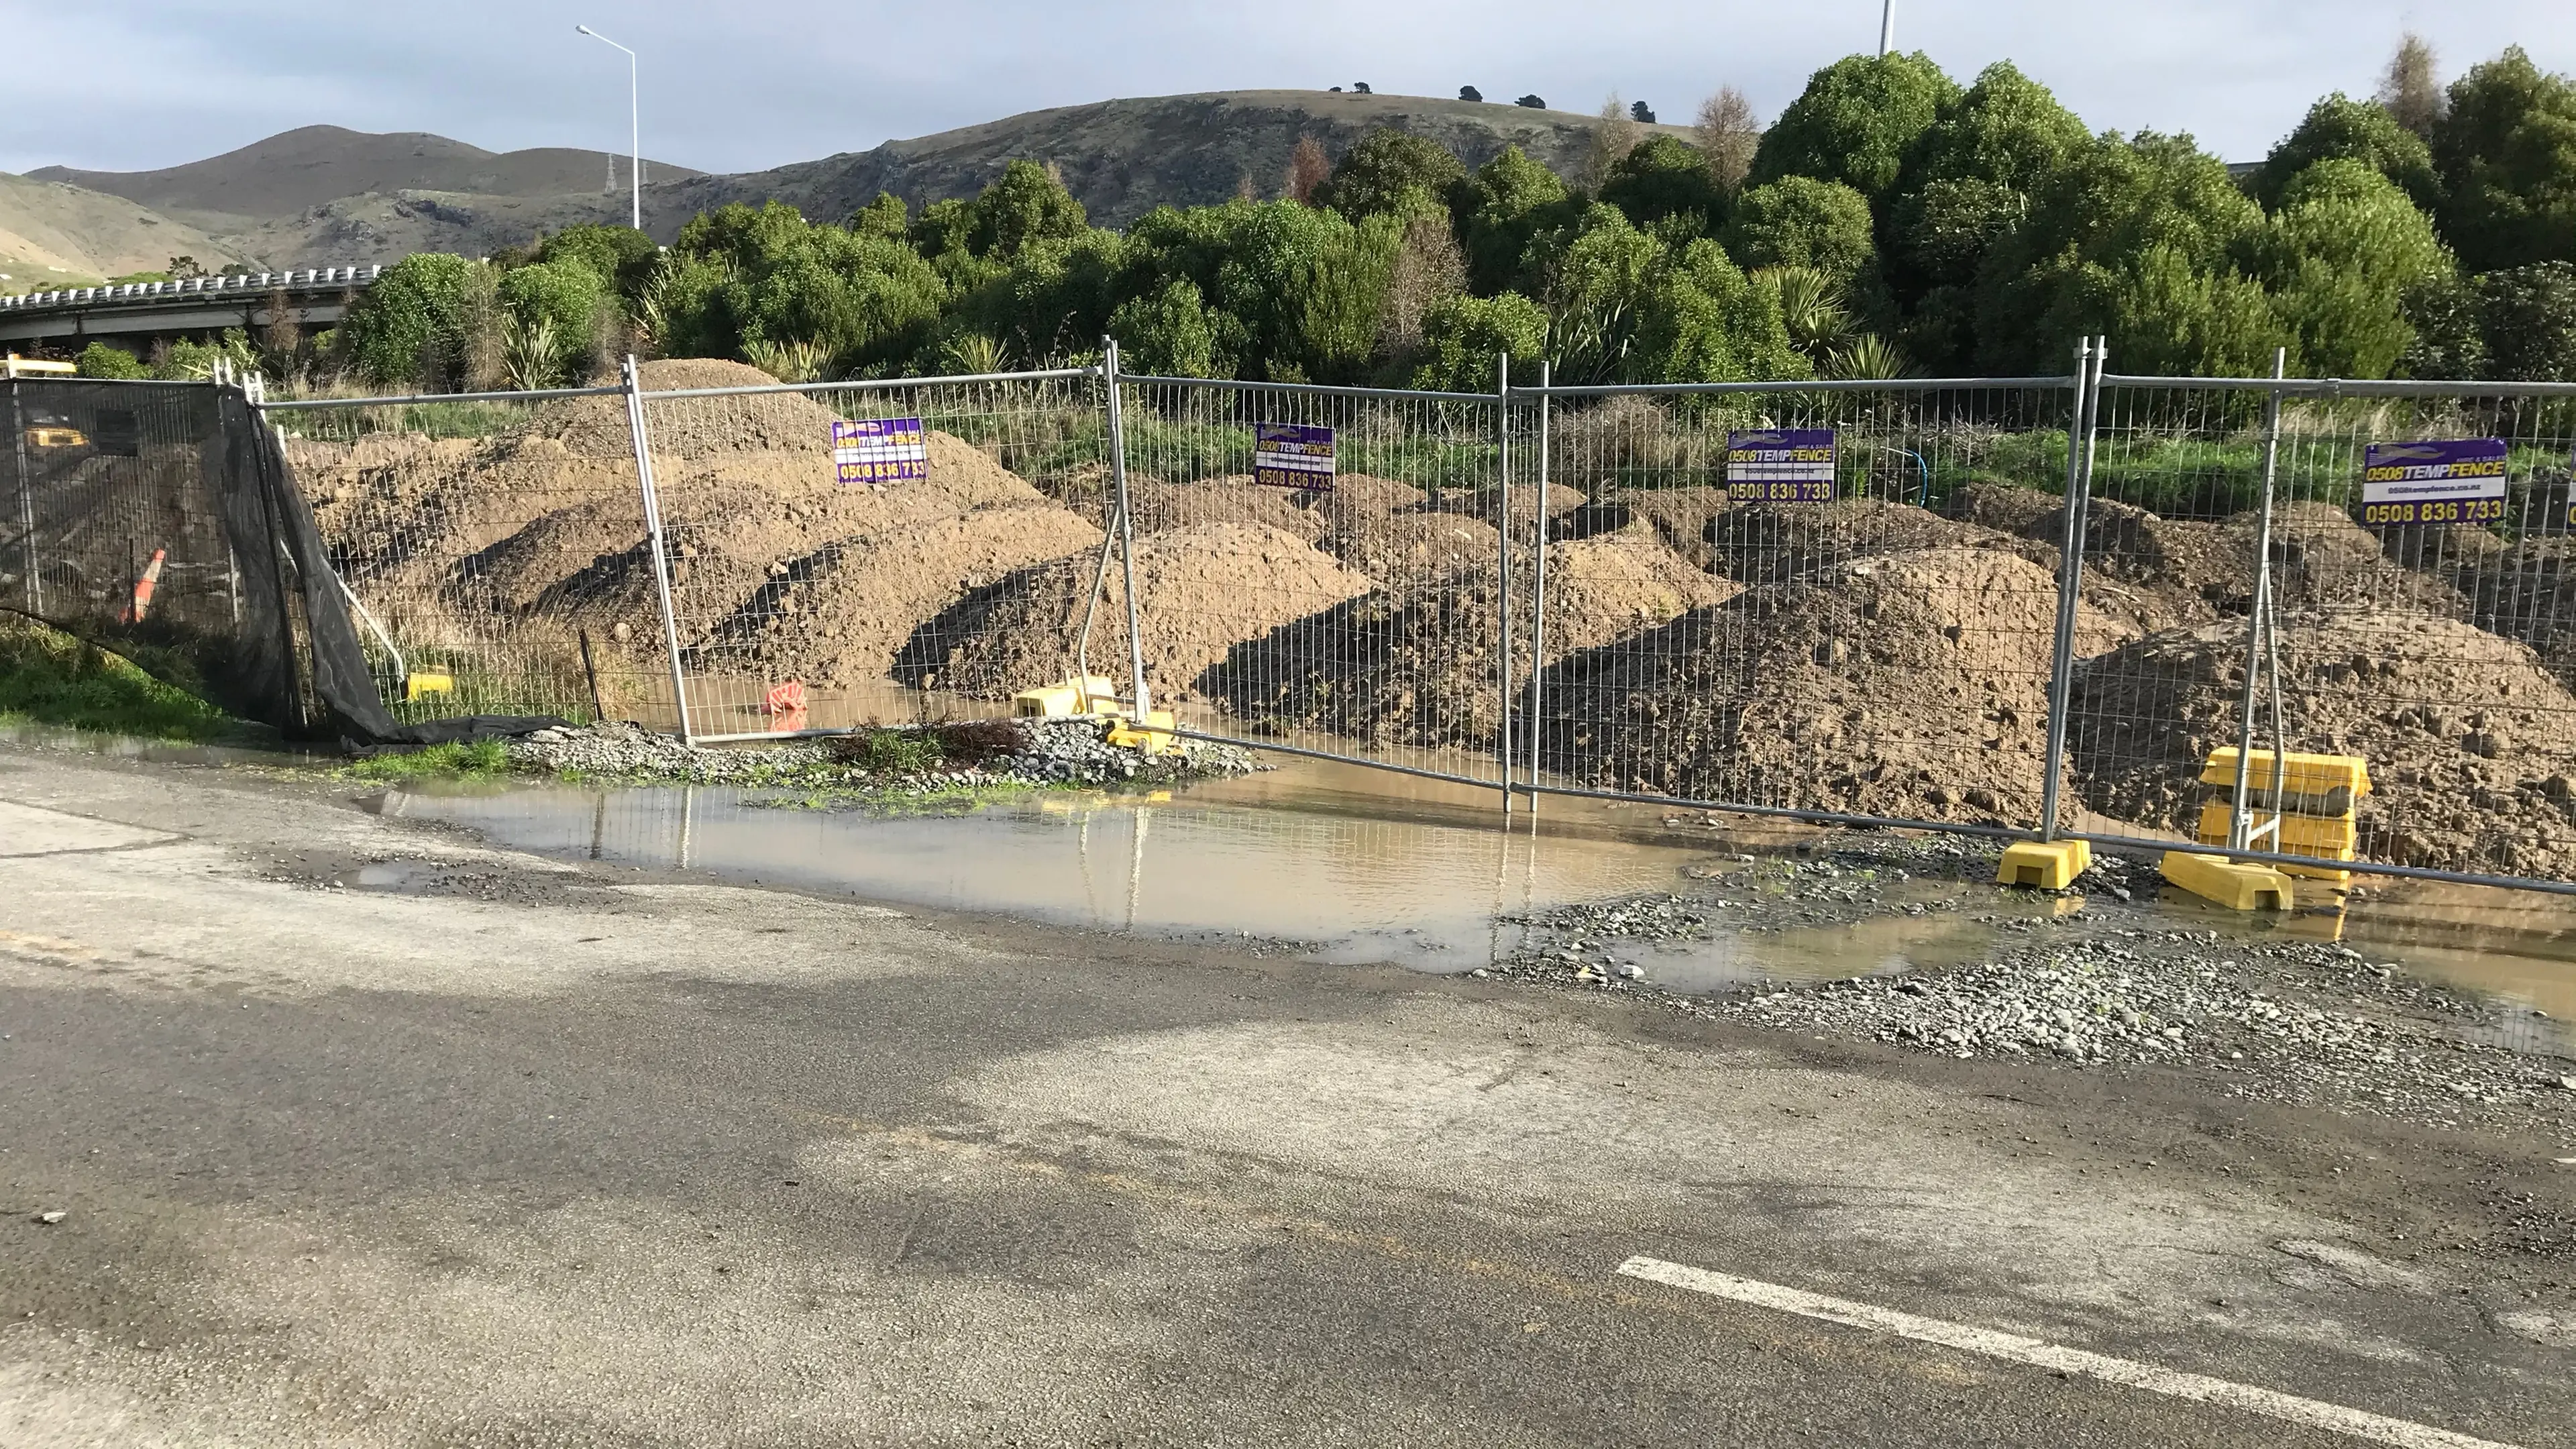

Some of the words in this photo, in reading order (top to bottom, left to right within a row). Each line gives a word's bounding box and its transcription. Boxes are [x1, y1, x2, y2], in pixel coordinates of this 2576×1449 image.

[1259, 440, 1332, 455] 0508TEMPFENCE
[1729, 449, 1832, 462] 0508TEMPFENCE
[841, 464, 872, 479] 0508
[875, 463, 899, 477] 836
[902, 461, 924, 476] 733
[1259, 469, 1285, 484] 0508
[1289, 472, 1308, 487] 836
[1311, 473, 1332, 489] 733
[2366, 461, 2505, 482] 0508TEMPFENCE
[1729, 483, 1765, 499] 0508
[1770, 483, 1798, 499] 836
[1803, 483, 1830, 499] 733
[2365, 503, 2414, 523] 0508
[2420, 502, 2458, 522] 836
[2465, 500, 2502, 520] 733
